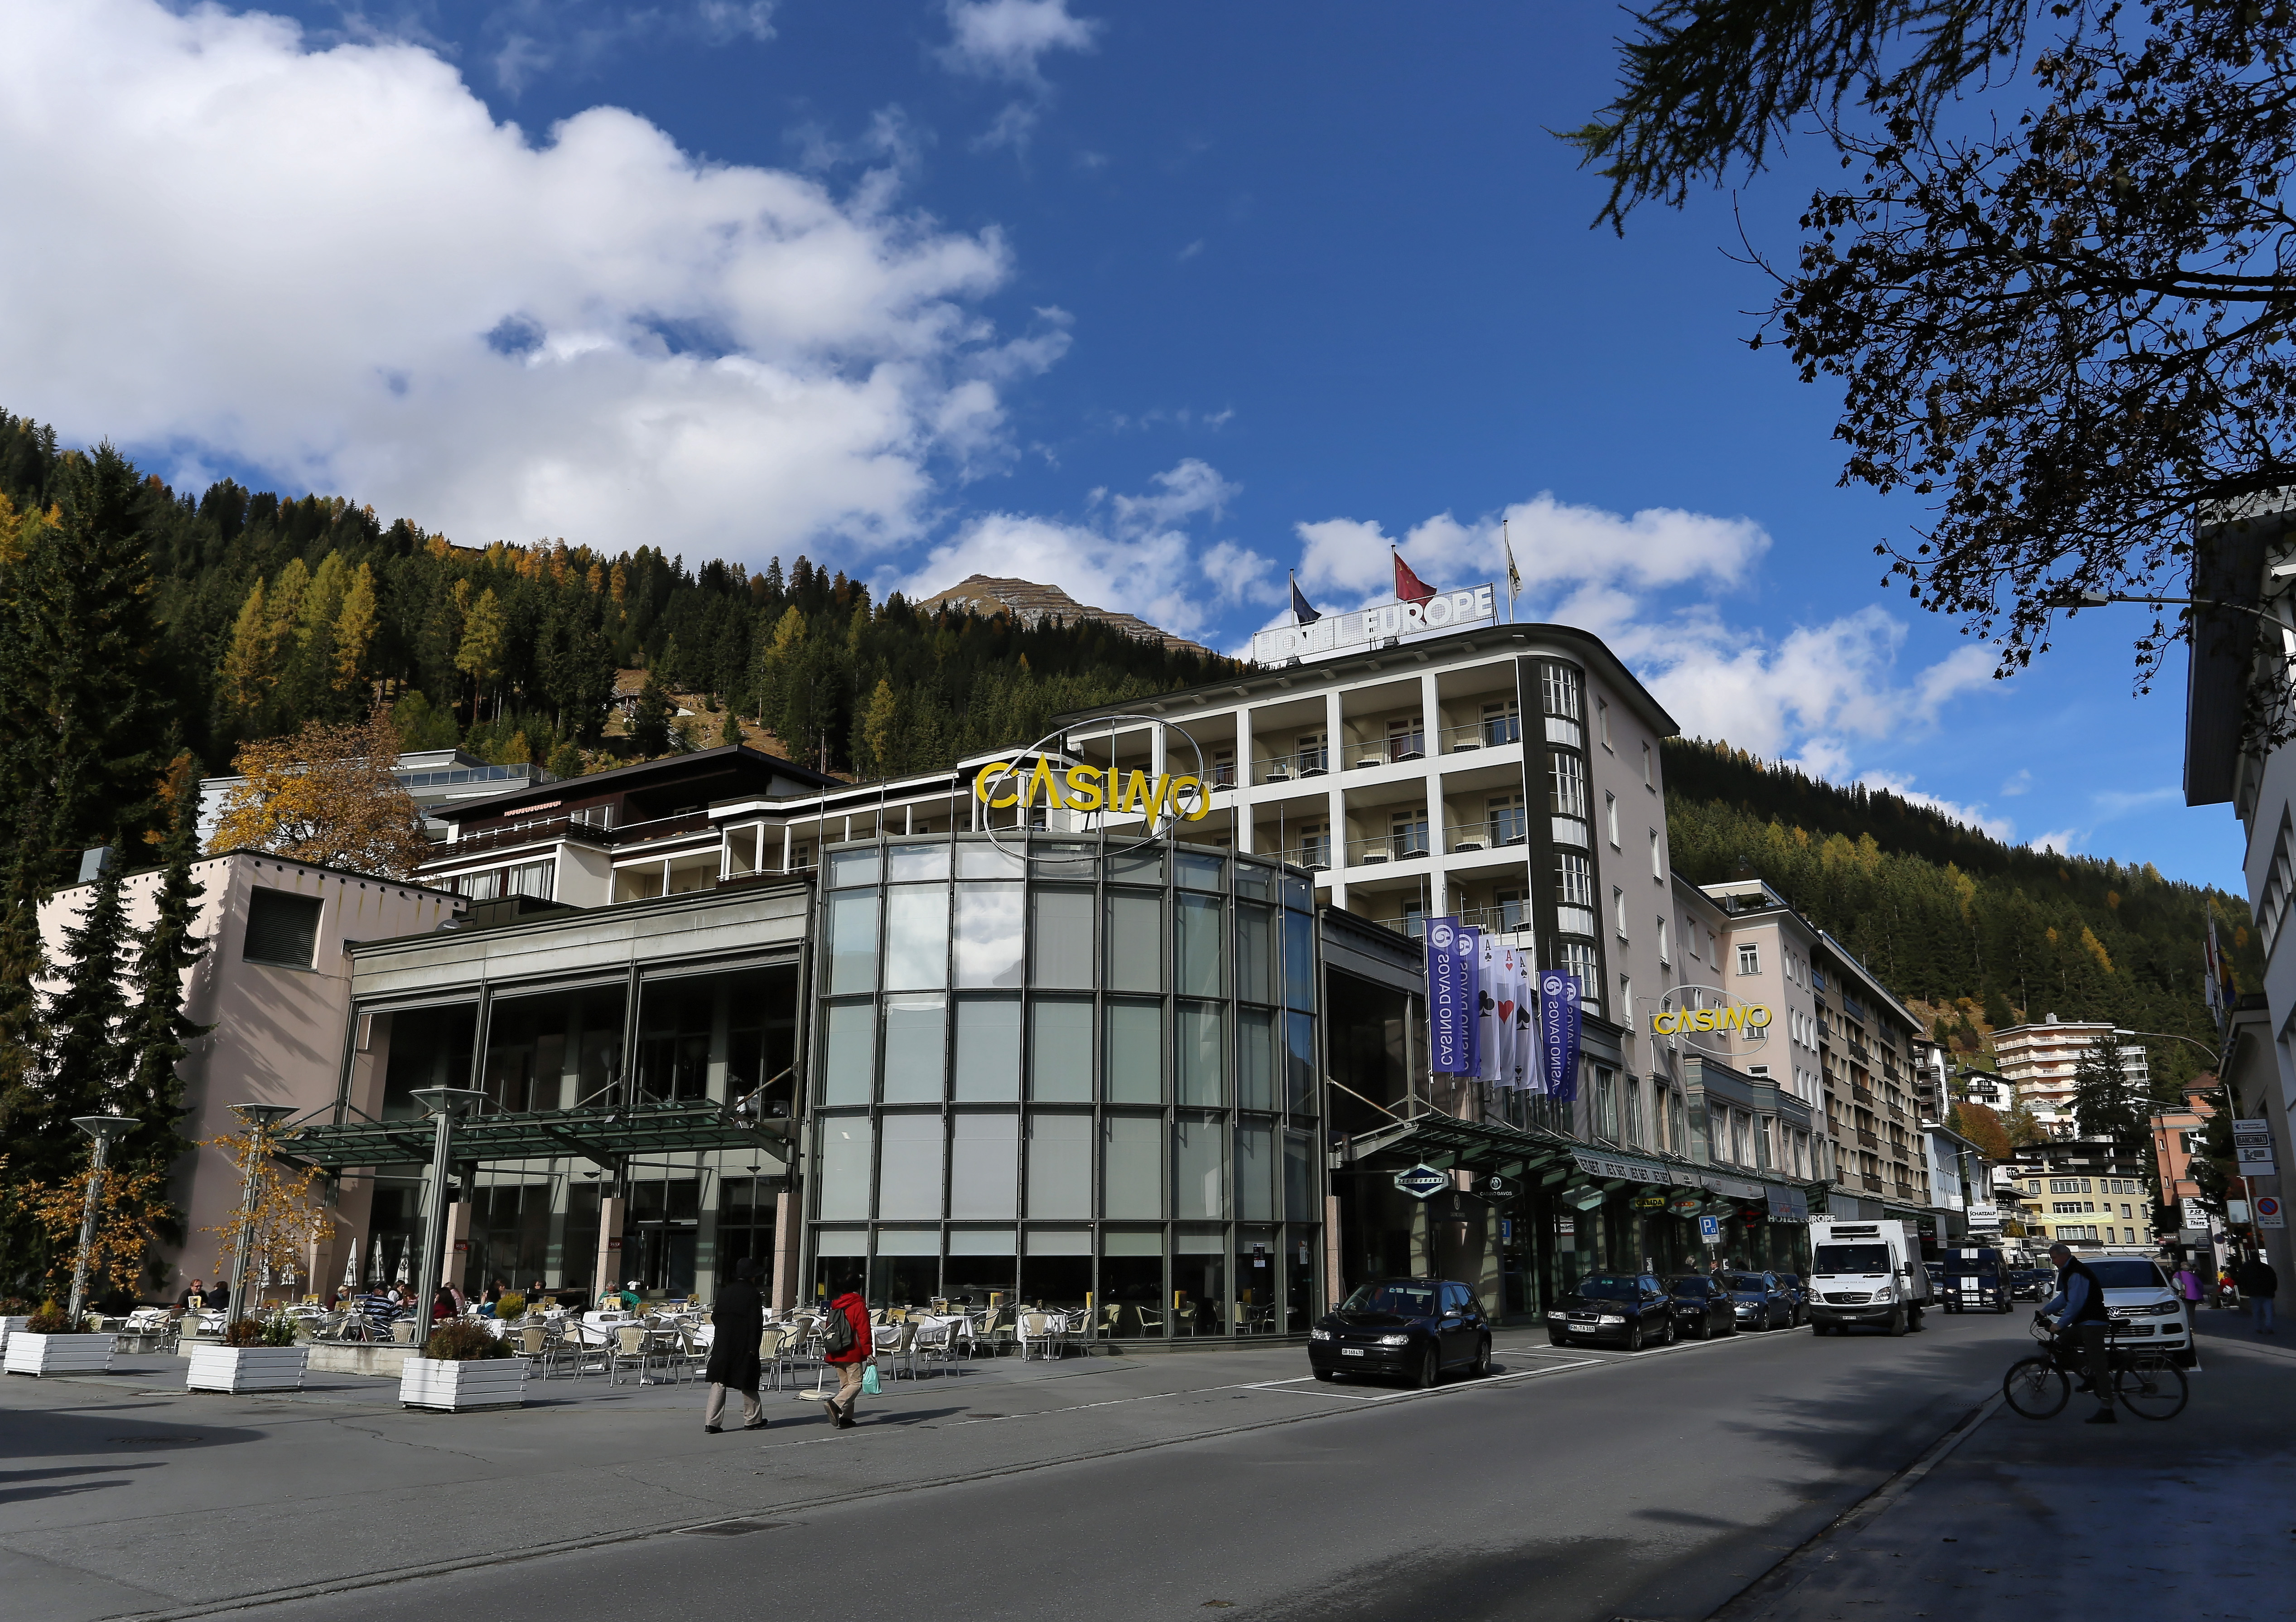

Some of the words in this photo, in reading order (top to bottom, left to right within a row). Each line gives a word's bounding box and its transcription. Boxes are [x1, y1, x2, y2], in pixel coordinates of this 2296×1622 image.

[1255, 618, 1351, 661] HOTEL
[1362, 586, 1492, 640] EUROPE
[975, 750, 1211, 830] CASINO
[1654, 1004, 1772, 1035] CASINO
[1703, 1219, 1712, 1232] P
